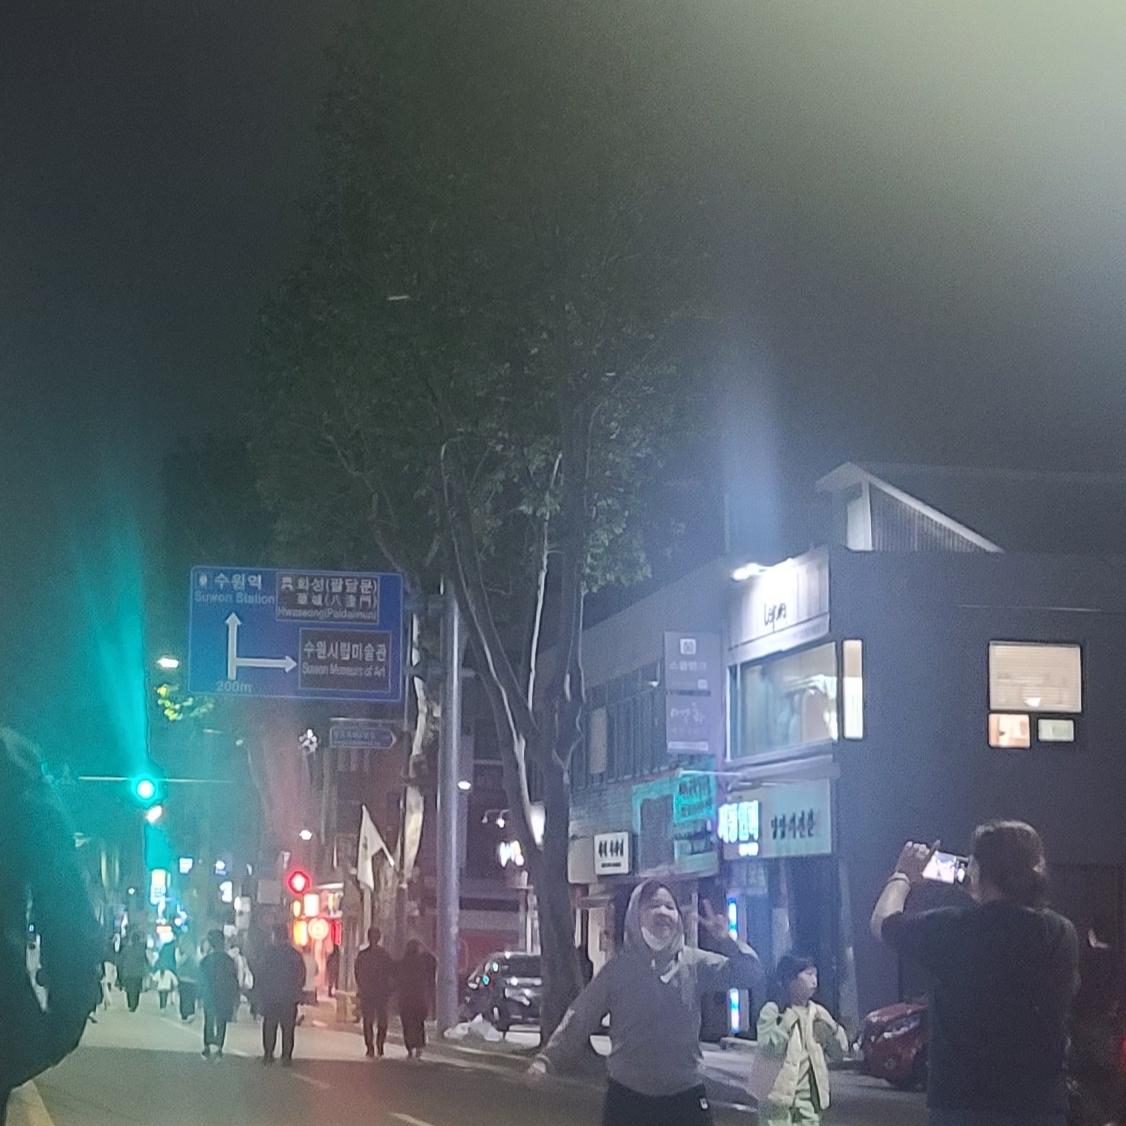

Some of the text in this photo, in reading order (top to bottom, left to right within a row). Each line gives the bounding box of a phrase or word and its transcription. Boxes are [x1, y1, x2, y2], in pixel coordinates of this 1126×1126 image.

[214, 573, 262, 590] 수원역
[296, 576, 377, 594] 화성(팔달문)
[194, 591, 274, 605] Suwon Station
[304, 640, 386, 661] 수원시립미술관
[302, 662, 328, 675] Suwon
